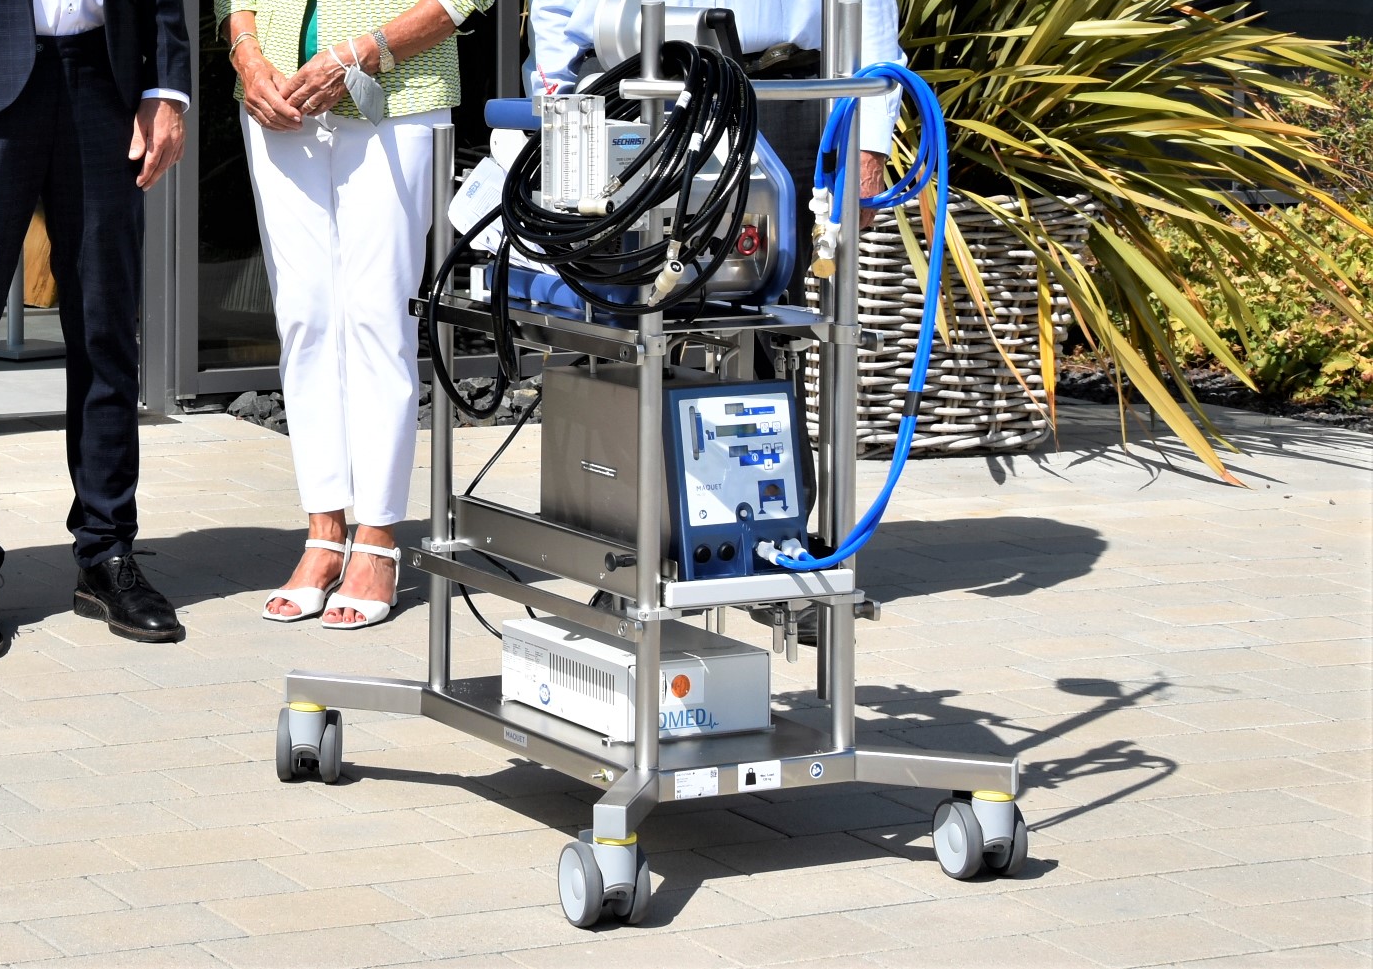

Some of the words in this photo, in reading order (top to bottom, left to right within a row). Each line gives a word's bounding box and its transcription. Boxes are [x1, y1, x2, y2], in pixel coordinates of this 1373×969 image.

[612, 137, 647, 146] SECHRIST
[696, 483, 722, 492] MAQUET
[505, 730, 526, 744] MAQUET
